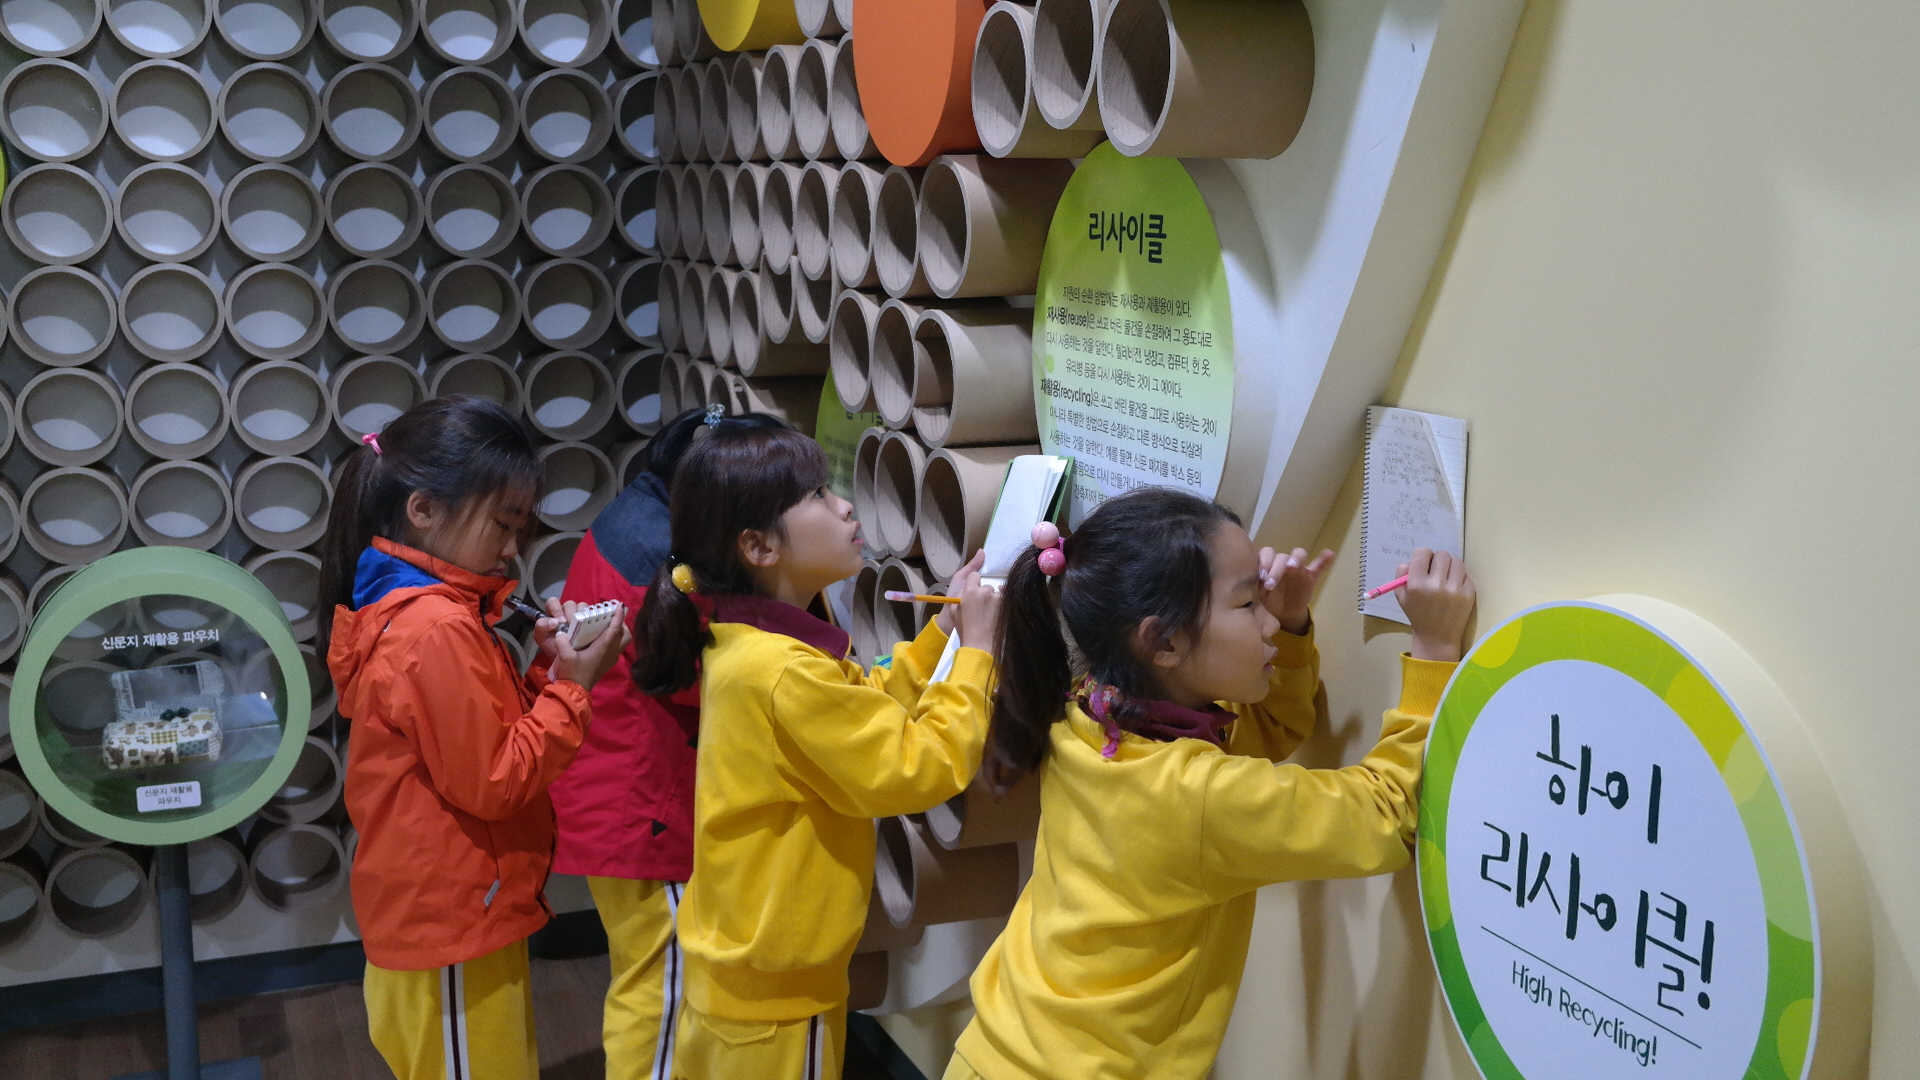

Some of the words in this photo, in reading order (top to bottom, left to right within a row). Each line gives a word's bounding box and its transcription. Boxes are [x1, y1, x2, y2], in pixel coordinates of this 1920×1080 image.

[1089, 211, 1166, 263] 리사이클
[1063, 286, 1080, 302] 자원의
[1082, 288, 1094, 304] 순환
[1095, 290, 1118, 307] 방법에는
[1120, 294, 1146, 312] 재사용과
[1147, 297, 1174, 316] 재활용이
[1176, 300, 1192, 318] 있다.
[1047, 306, 1095, 330] 재사용(reuse)은
[1096, 316, 1109, 330] 쓰고
[1110, 318, 1122, 334] 버린
[1124, 320, 1143, 338] 물건을
[1145, 324, 1172, 342] 손질하여
[1174, 328, 1180, 342] 그
[1183, 328, 1212, 348] 용도대로
[1059, 334, 1080, 351] 사용하는
[1082, 337, 1094, 354] 것을
[1168, 354, 1190, 373] 컴퓨터,
[1192, 356, 1200, 374] 헌
[1066, 358, 1082, 376] 유리병
[1084, 362, 1096, 380] 등을
[1098, 366, 1110, 382] 다시
[1111, 369, 1136, 388] 사용하는
[1137, 374, 1150, 392] 것이
[1152, 378, 1159, 392] 그
[1040, 378, 1100, 408] 재활용(recycling)은
[1100, 395, 1112, 409] 쓰고
[1114, 398, 1126, 414] 버린
[1128, 400, 1148, 420] 물건을
[1149, 407, 1170, 424] 그대로
[1170, 412, 1200, 432] 사용하는
[1202, 418, 1217, 436] 것이
[1050, 406, 1066, 423] 아니라
[1068, 410, 1084, 428] 특별한
[1086, 414, 1109, 434] 방법으로
[1110, 422, 1134, 440] 손질하고
[1136, 428, 1150, 446] 다른
[1152, 432, 1178, 453] 방식으로
[1180, 440, 1202, 460] 되살려
[1050, 430, 1071, 448] 사용하는
[1072, 436, 1084, 452] 것을
[1085, 439, 1104, 458] 말한다.
[1106, 446, 1118, 462] 예를
[1120, 448, 1132, 466] 들면
[1134, 454, 1146, 472] 신문
[1170, 464, 1185, 480] 박스
[1186, 468, 1202, 488] 등의
[1096, 468, 1109, 484] 다시
[102, 635, 138, 650] 신문지
[143, 632, 180, 647] 재활용
[183, 629, 219, 642] 파우치
[144, 788, 168, 797] 신문지
[1536, 714, 1662, 844] 하이
[1480, 821, 1714, 1017] 리사이클!
[1512, 960, 1552, 1006] High
[1559, 987, 1658, 1066] Recycling!
